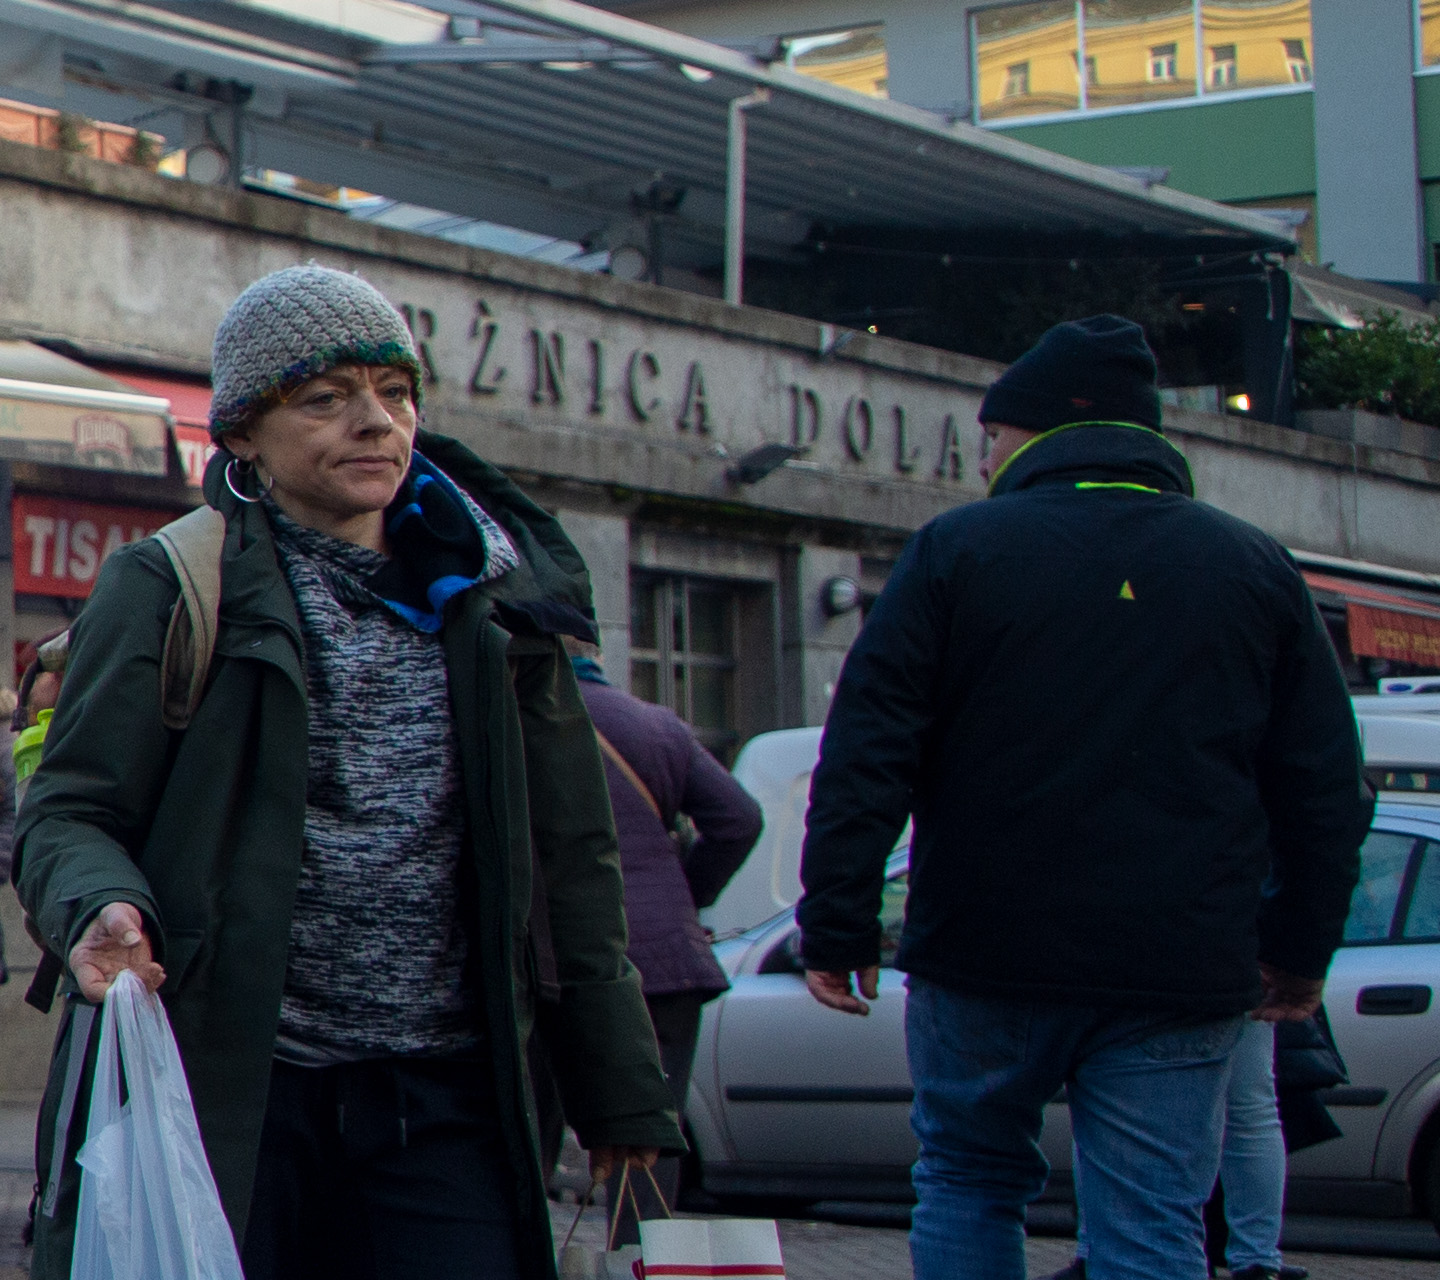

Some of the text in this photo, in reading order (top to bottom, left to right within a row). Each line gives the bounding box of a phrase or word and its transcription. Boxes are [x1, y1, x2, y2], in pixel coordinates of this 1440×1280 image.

[402, 300, 989, 482] RŽNICA DOLA
[25, 515, 160, 581] TISA
